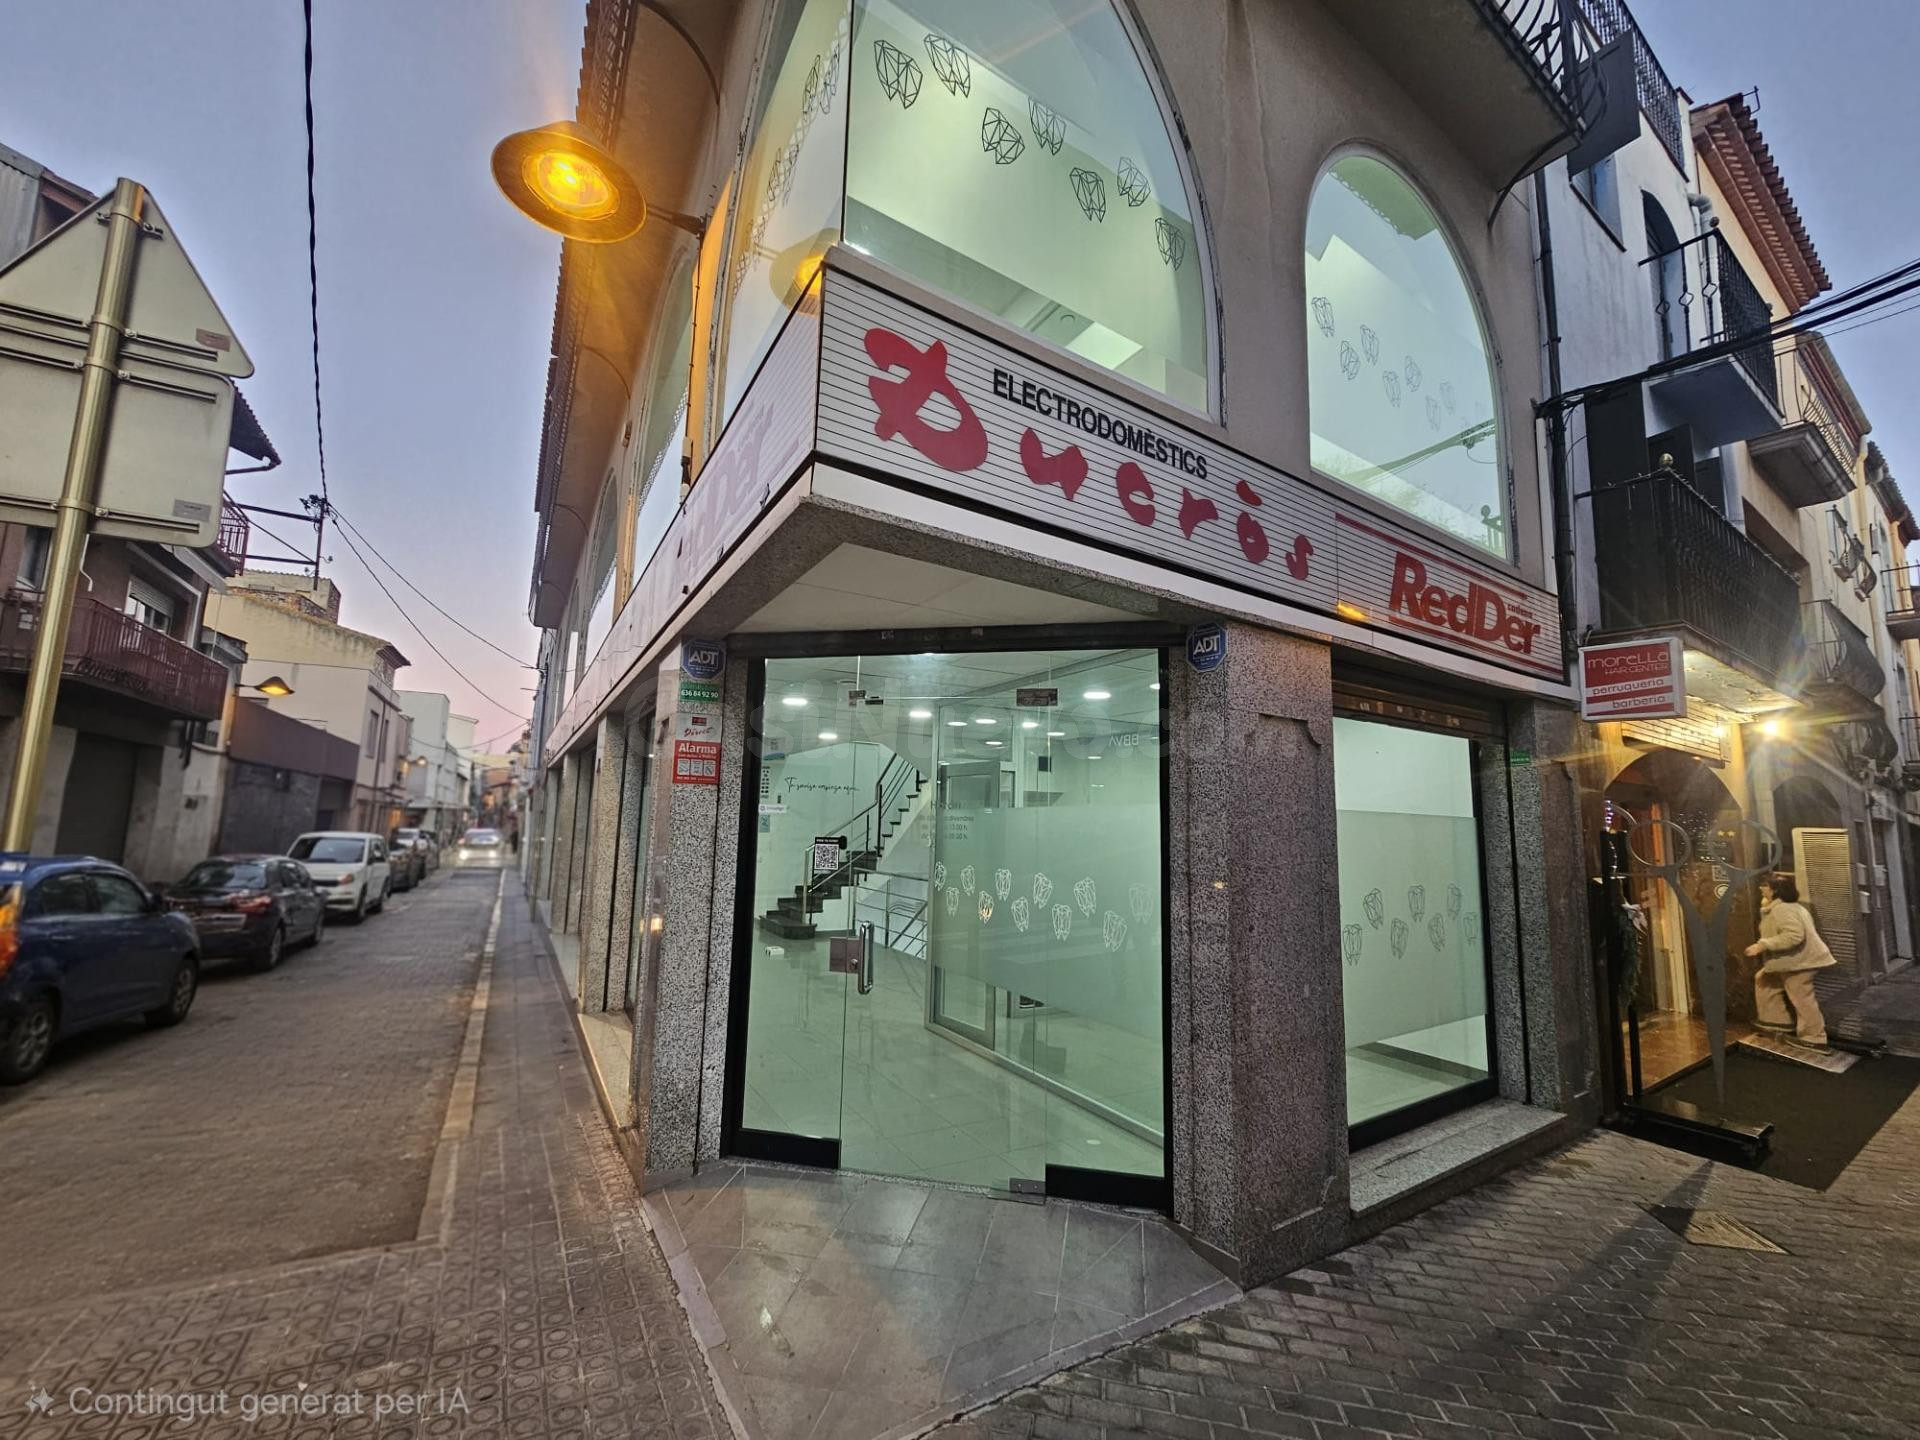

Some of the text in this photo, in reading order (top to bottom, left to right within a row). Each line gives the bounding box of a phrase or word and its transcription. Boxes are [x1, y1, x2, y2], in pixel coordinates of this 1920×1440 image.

[993, 367, 1208, 480] ELECTRODOMÈSTICS
[1389, 551, 1541, 654] RedDer
[1192, 634, 1220, 655] ADT
[689, 650, 719, 665] ADT
[678, 742, 717, 754] Alarma
